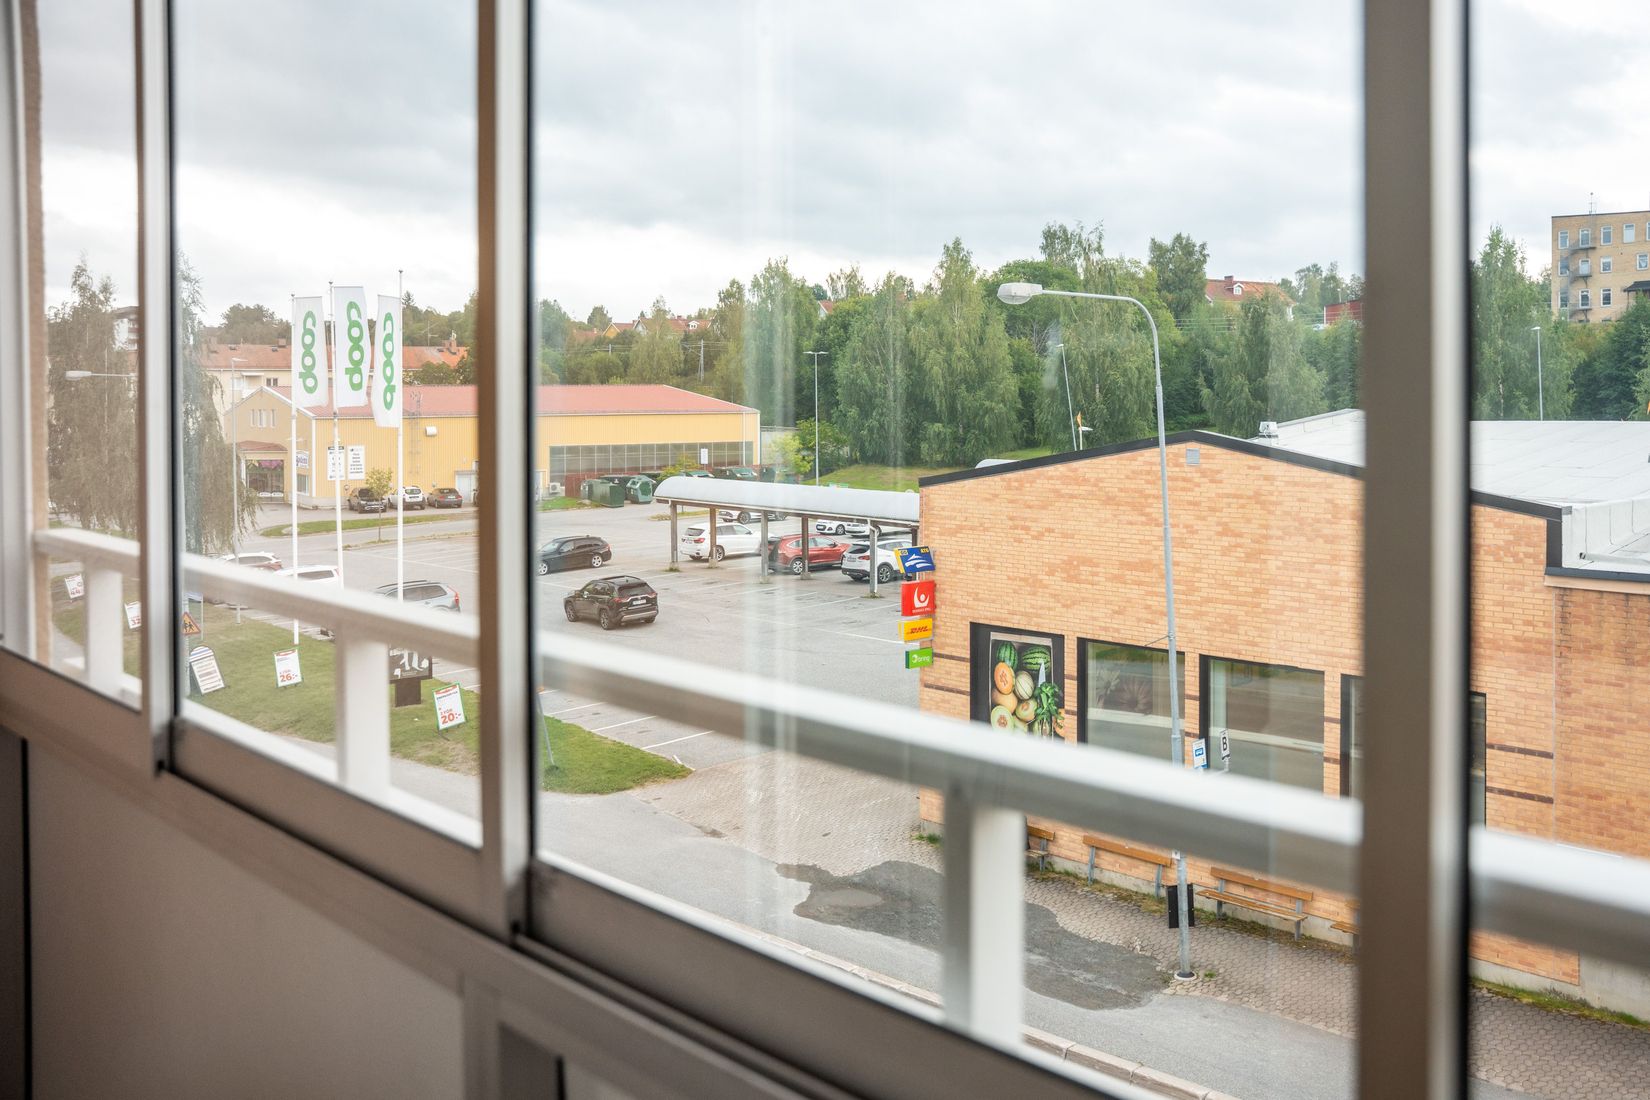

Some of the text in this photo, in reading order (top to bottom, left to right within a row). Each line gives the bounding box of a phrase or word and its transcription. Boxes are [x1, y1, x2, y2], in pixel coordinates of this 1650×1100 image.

[298, 310, 318, 394] coop
[345, 301, 365, 391] coop
[382, 312, 396, 411] coop
[441, 712, 461, 725] 20:-
[1222, 736, 1228, 751] B
